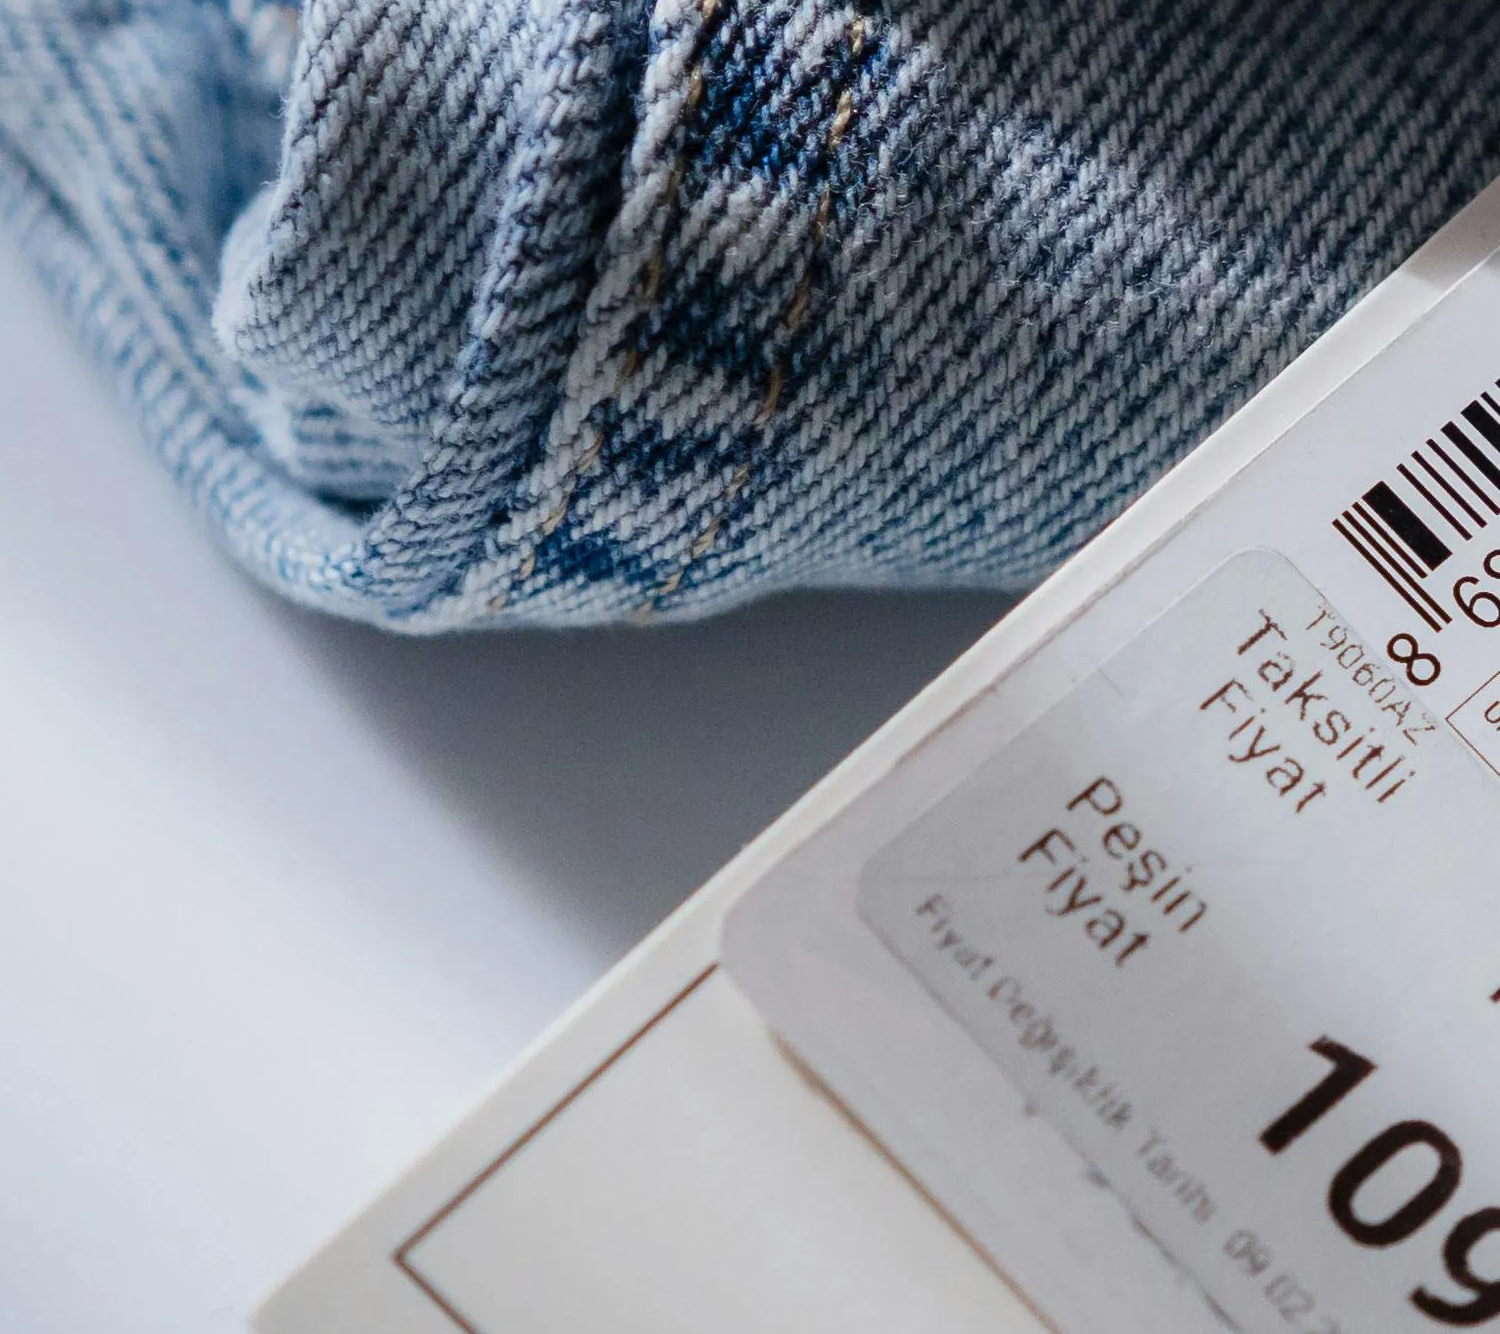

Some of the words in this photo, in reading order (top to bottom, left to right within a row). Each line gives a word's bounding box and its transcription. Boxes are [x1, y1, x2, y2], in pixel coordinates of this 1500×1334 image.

[1199, 678, 1327, 814] Fiyat
[1237, 608, 1416, 804] Taksitli
[1017, 827, 1151, 968] Fiyat
[1065, 775, 1208, 934] Peşin
